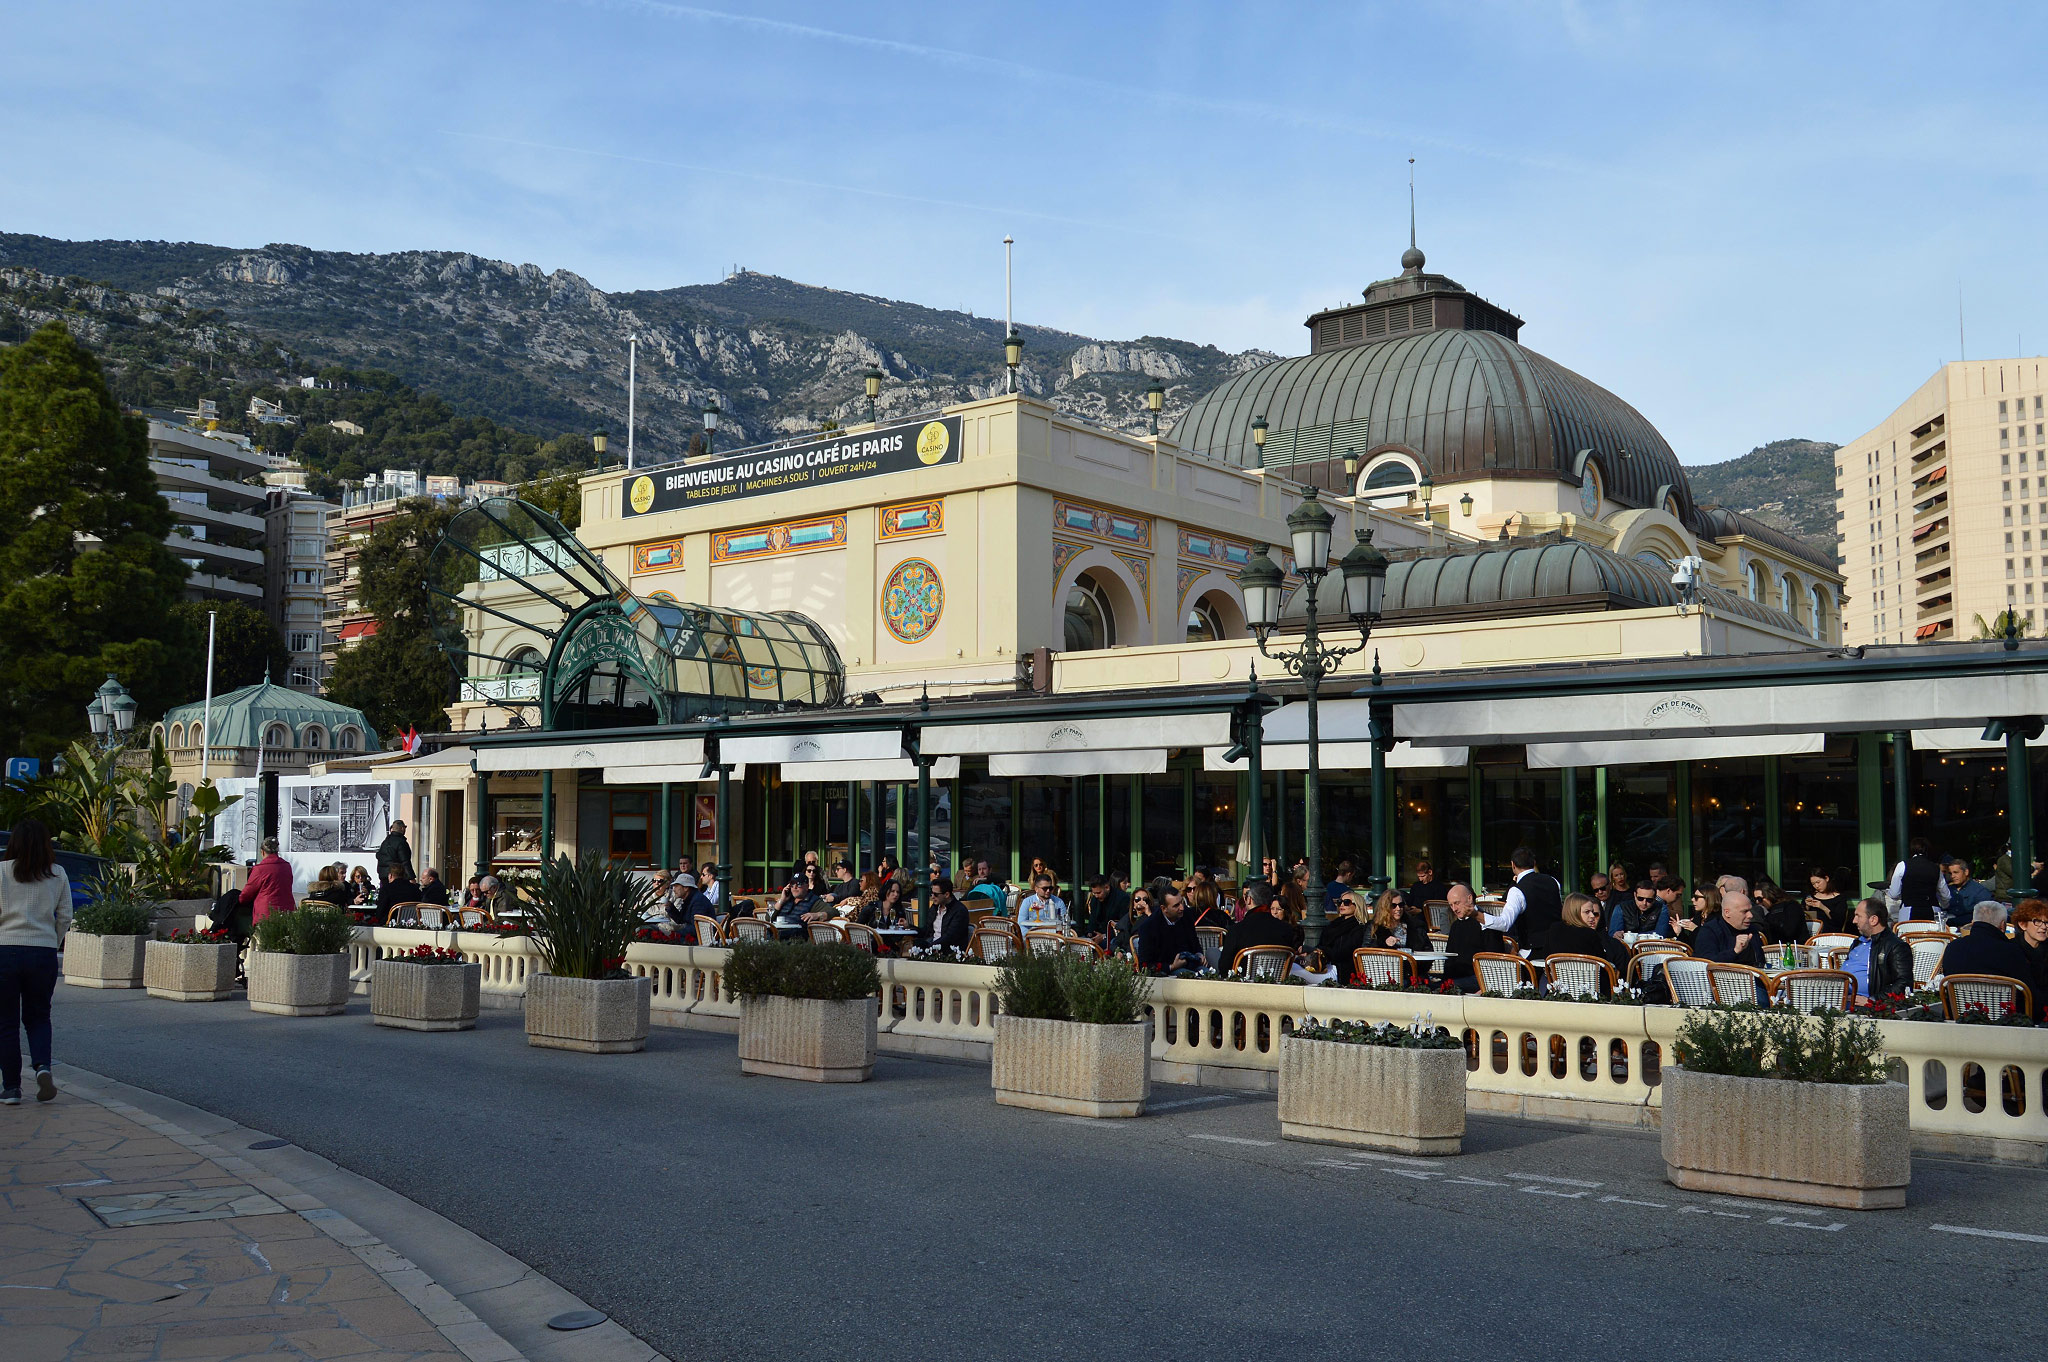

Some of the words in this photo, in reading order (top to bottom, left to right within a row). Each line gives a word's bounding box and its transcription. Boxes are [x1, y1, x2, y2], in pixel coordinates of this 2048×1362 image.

[921, 443, 944, 453] CASINO
[666, 466, 734, 491] BIENVENUE
[735, 463, 754, 480] AU
[755, 453, 804, 476] CASINO
[806, 442, 840, 467] CAFÉ
[841, 441, 860, 460] DE
[862, 434, 903, 457] PARIS
[686, 487, 710, 499] TABLES
[710, 486, 720, 495] DE
[720, 484, 737, 496] JEUX
[746, 476, 782, 490] MACHINES
[789, 471, 809, 482] SOUS
[818, 464, 849, 478] OUVERT
[849, 461, 877, 472] 24H/24
[633, 495, 651, 503] CASINO
[596, 627, 610, 645] DE
[1681, 701, 1702, 713] PARIS
[18, 762, 30, 777] P
[825, 787, 848, 799] L'ECAILL
